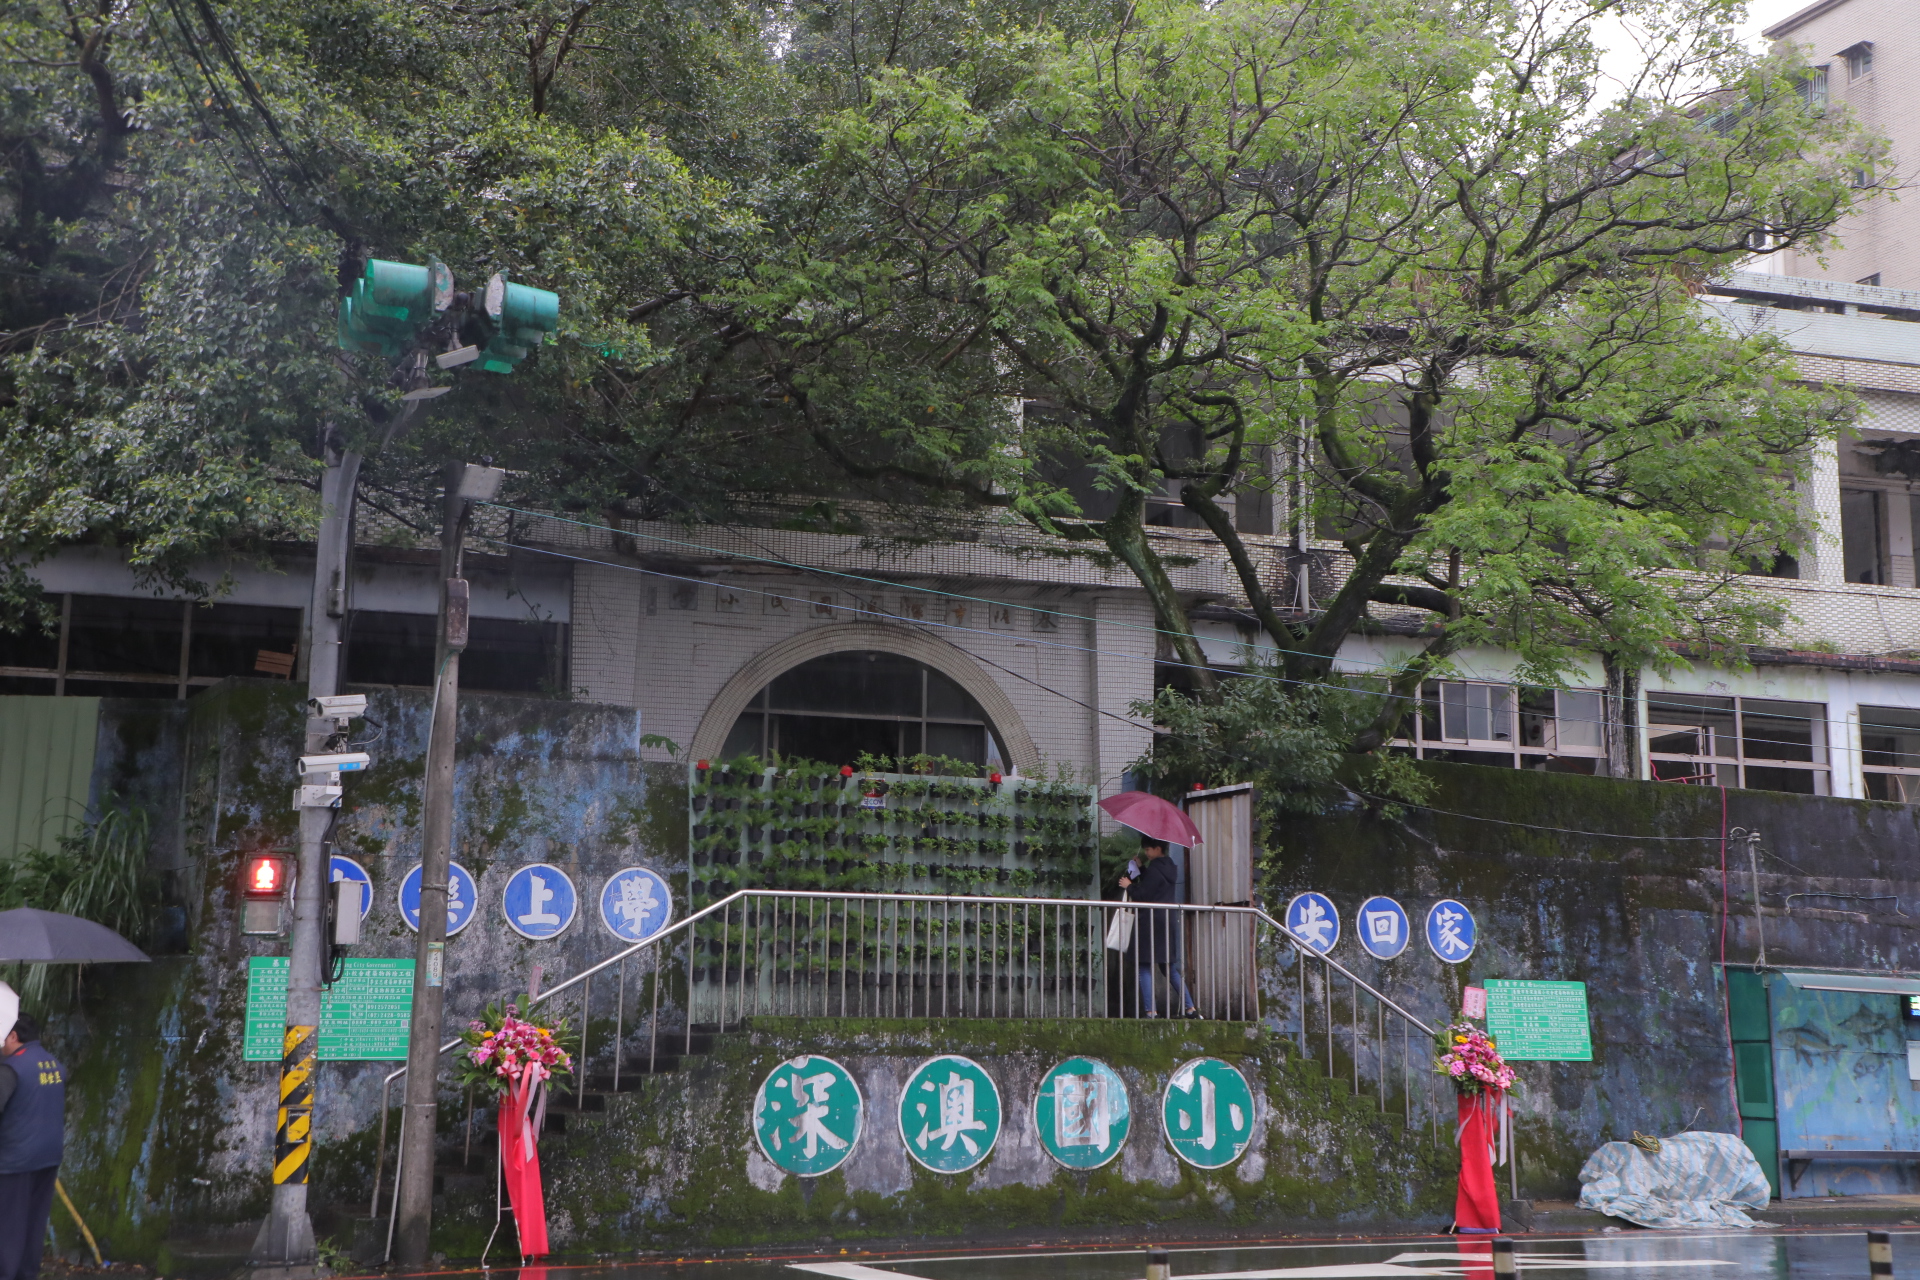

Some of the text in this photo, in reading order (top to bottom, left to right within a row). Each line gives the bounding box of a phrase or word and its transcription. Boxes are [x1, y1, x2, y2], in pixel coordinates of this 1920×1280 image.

[1292, 894, 1470, 955] 安回家
[771, 1072, 1243, 1159] 深澳國小
